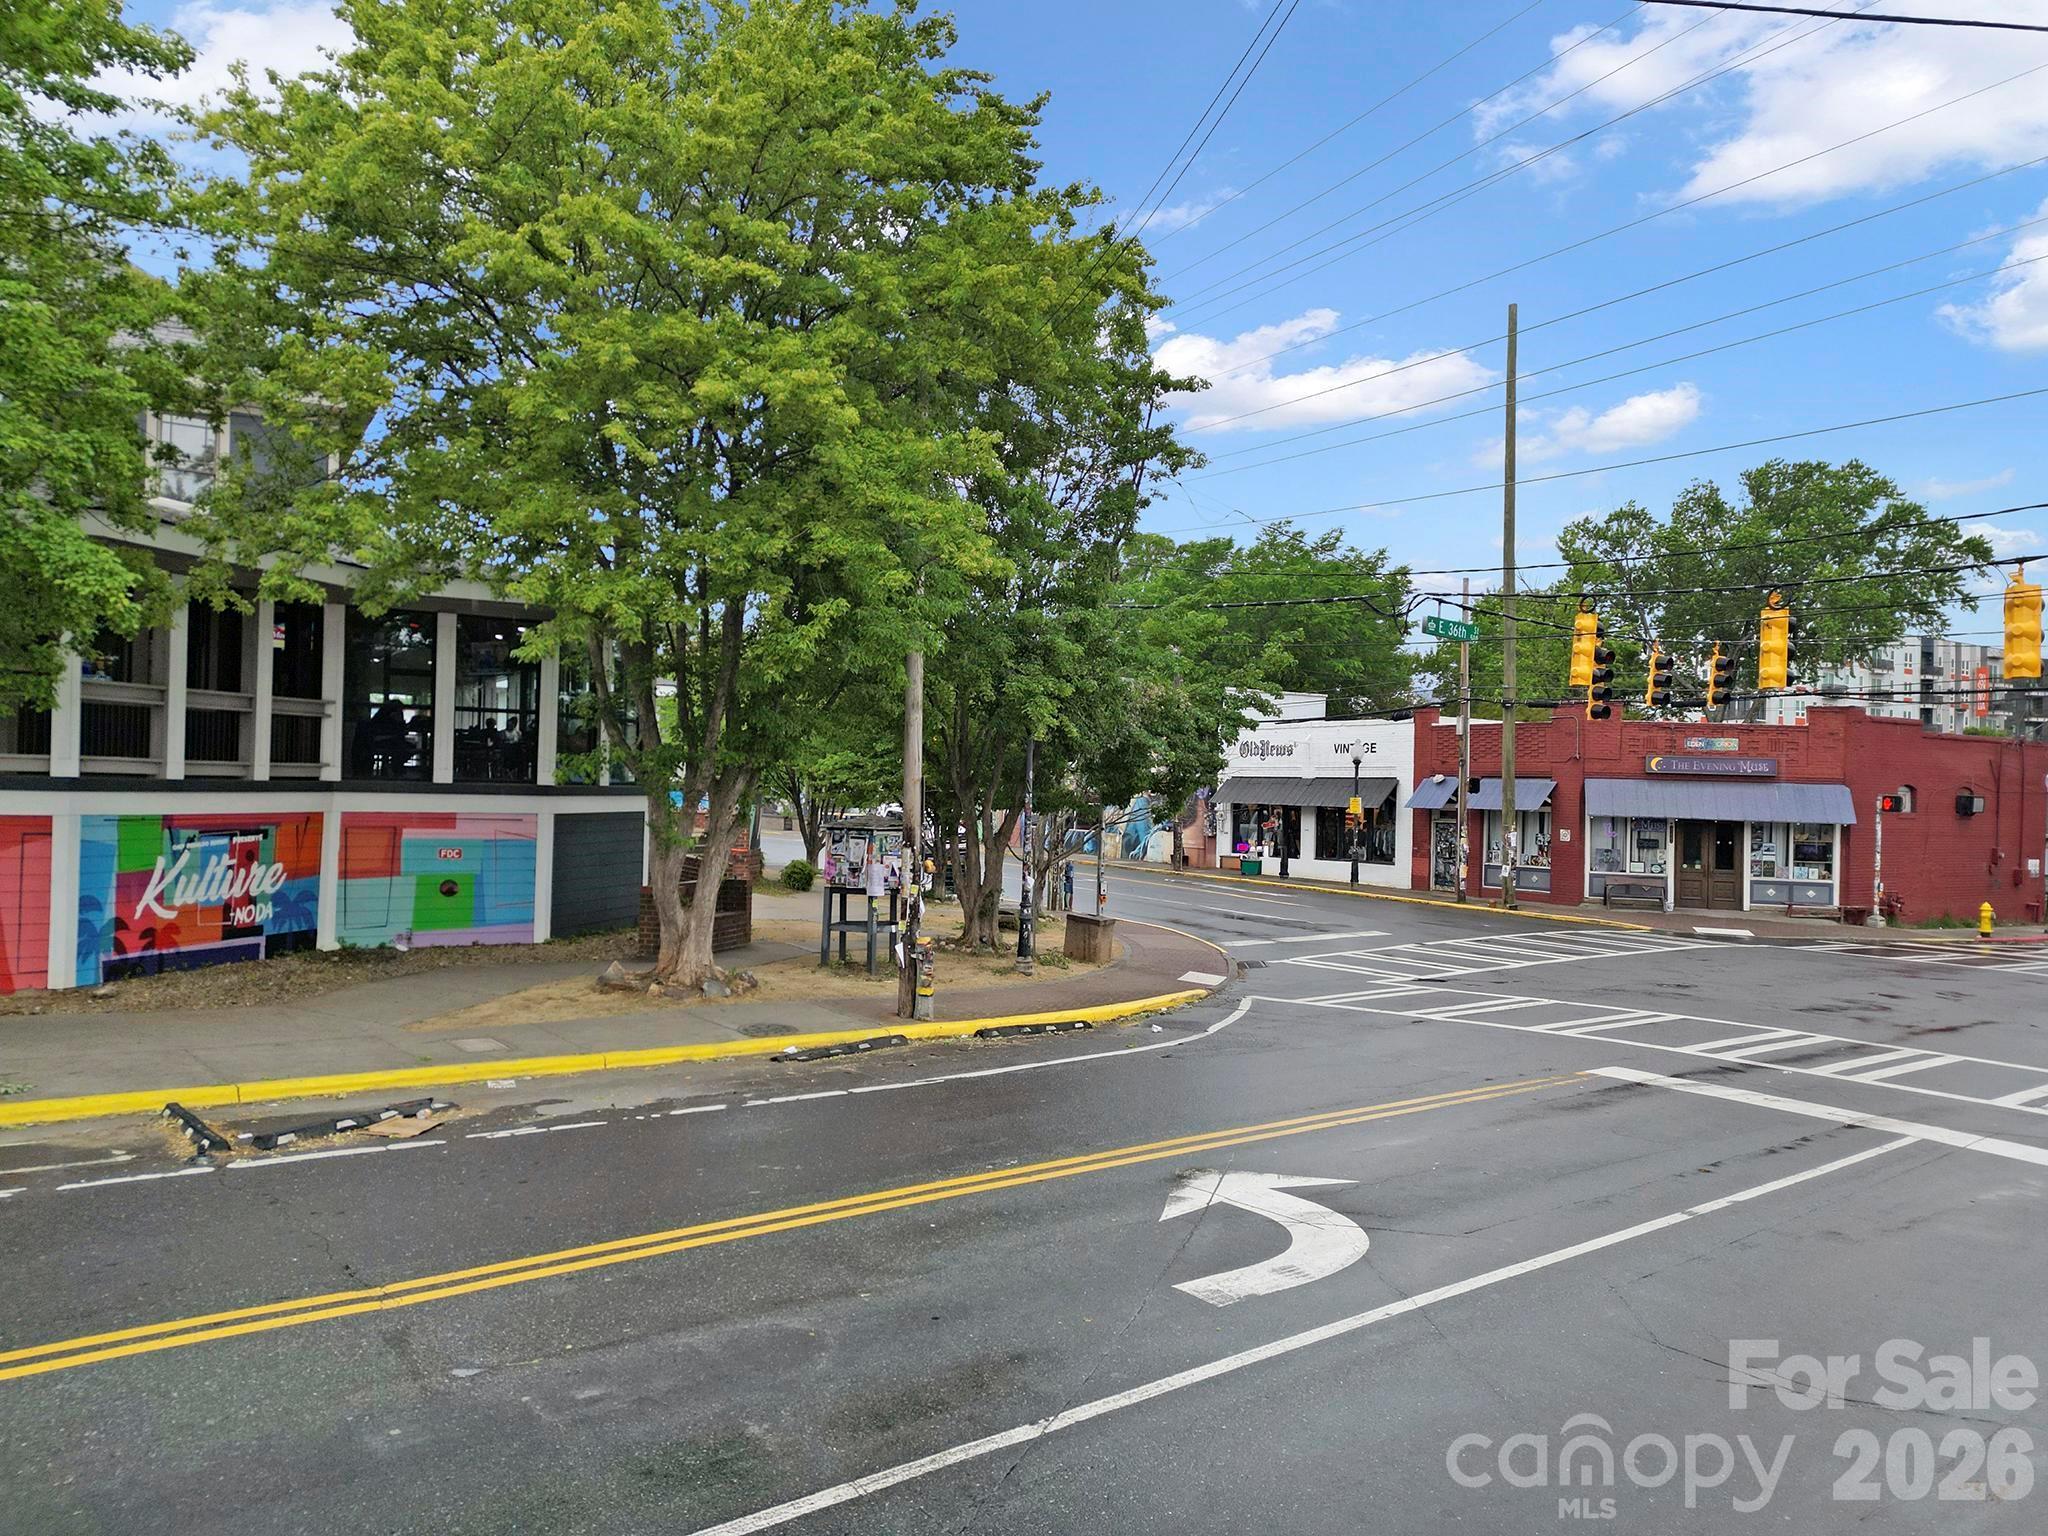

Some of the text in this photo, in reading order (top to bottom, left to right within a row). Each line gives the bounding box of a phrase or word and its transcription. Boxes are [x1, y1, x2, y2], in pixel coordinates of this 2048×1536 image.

[1439, 621, 1445, 633] E
[1448, 623, 1466, 638] 36th
[1334, 742, 1377, 754] VINGE
[441, 849, 461, 858] FDC
[134, 849, 288, 920] Kulture
